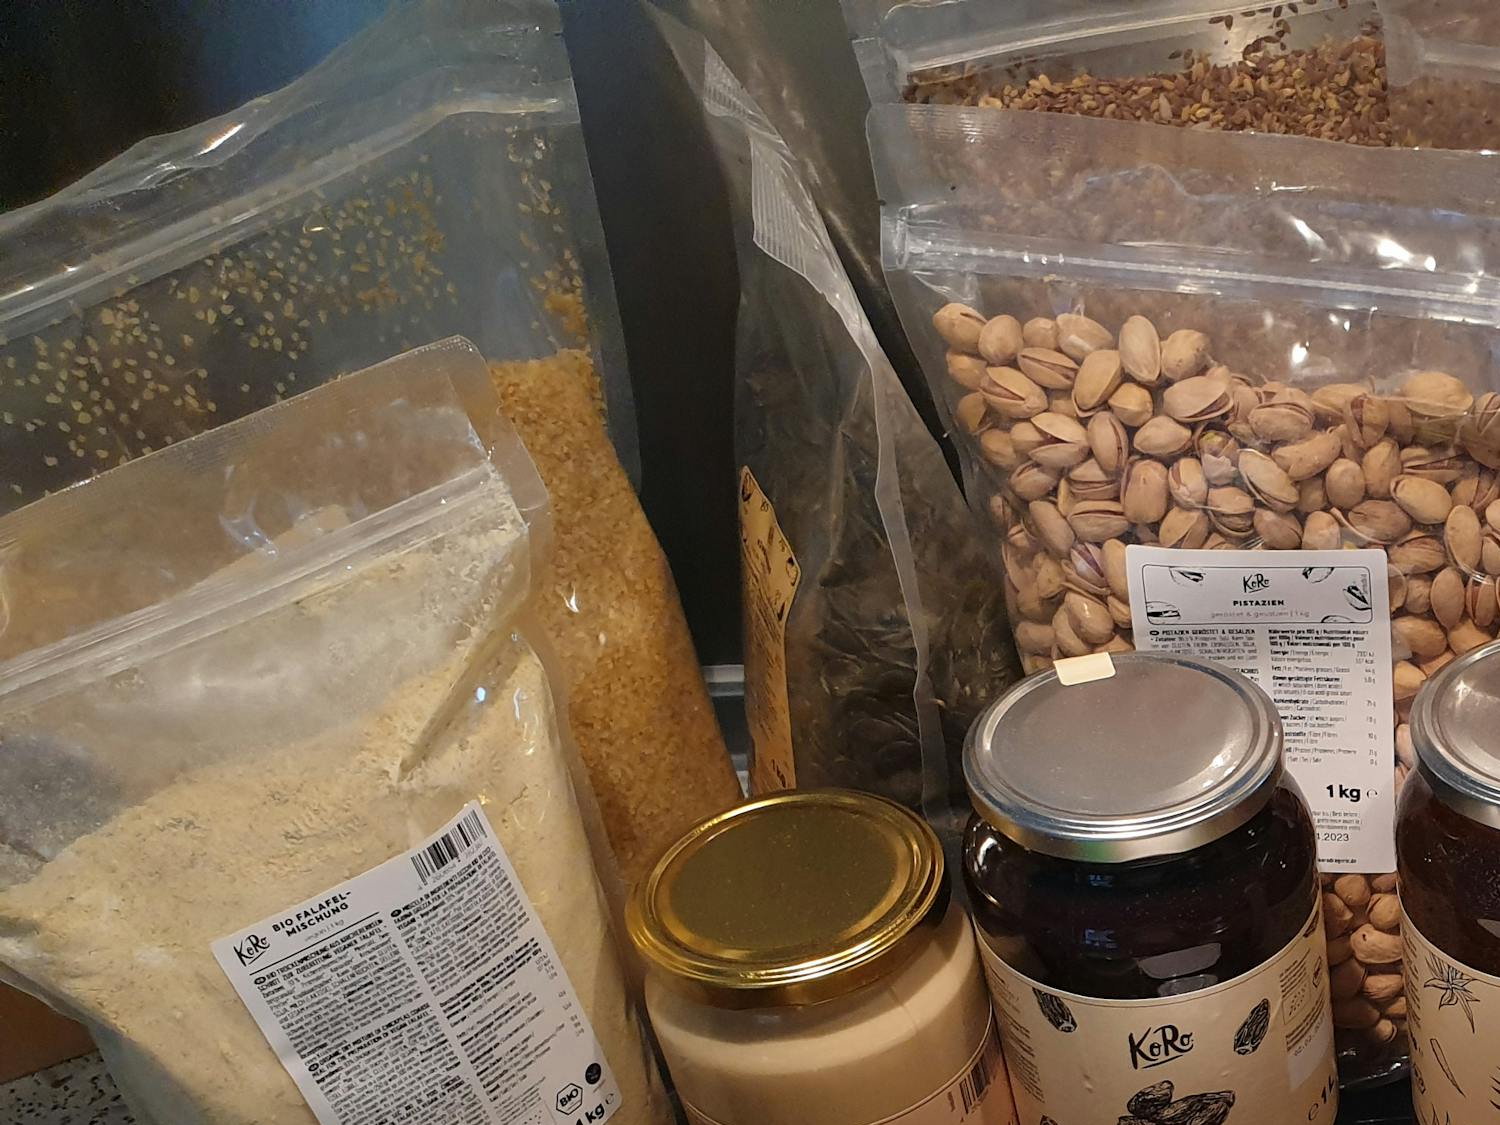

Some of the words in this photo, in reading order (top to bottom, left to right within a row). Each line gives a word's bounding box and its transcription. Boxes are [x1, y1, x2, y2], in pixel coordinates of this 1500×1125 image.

[1243, 573, 1270, 593] KoRo
[1326, 784, 1334, 798] 1
[1339, 784, 1361, 802] kg
[272, 918, 294, 932] BIO
[296, 891, 352, 921] FALAFEL-
[286, 902, 349, 937] MISCHUNG
[233, 934, 271, 967] KoRo
[1128, 1024, 1194, 1070] KoRo
[560, 1088, 579, 1107] BIO
[586, 1102, 605, 1124] kg
